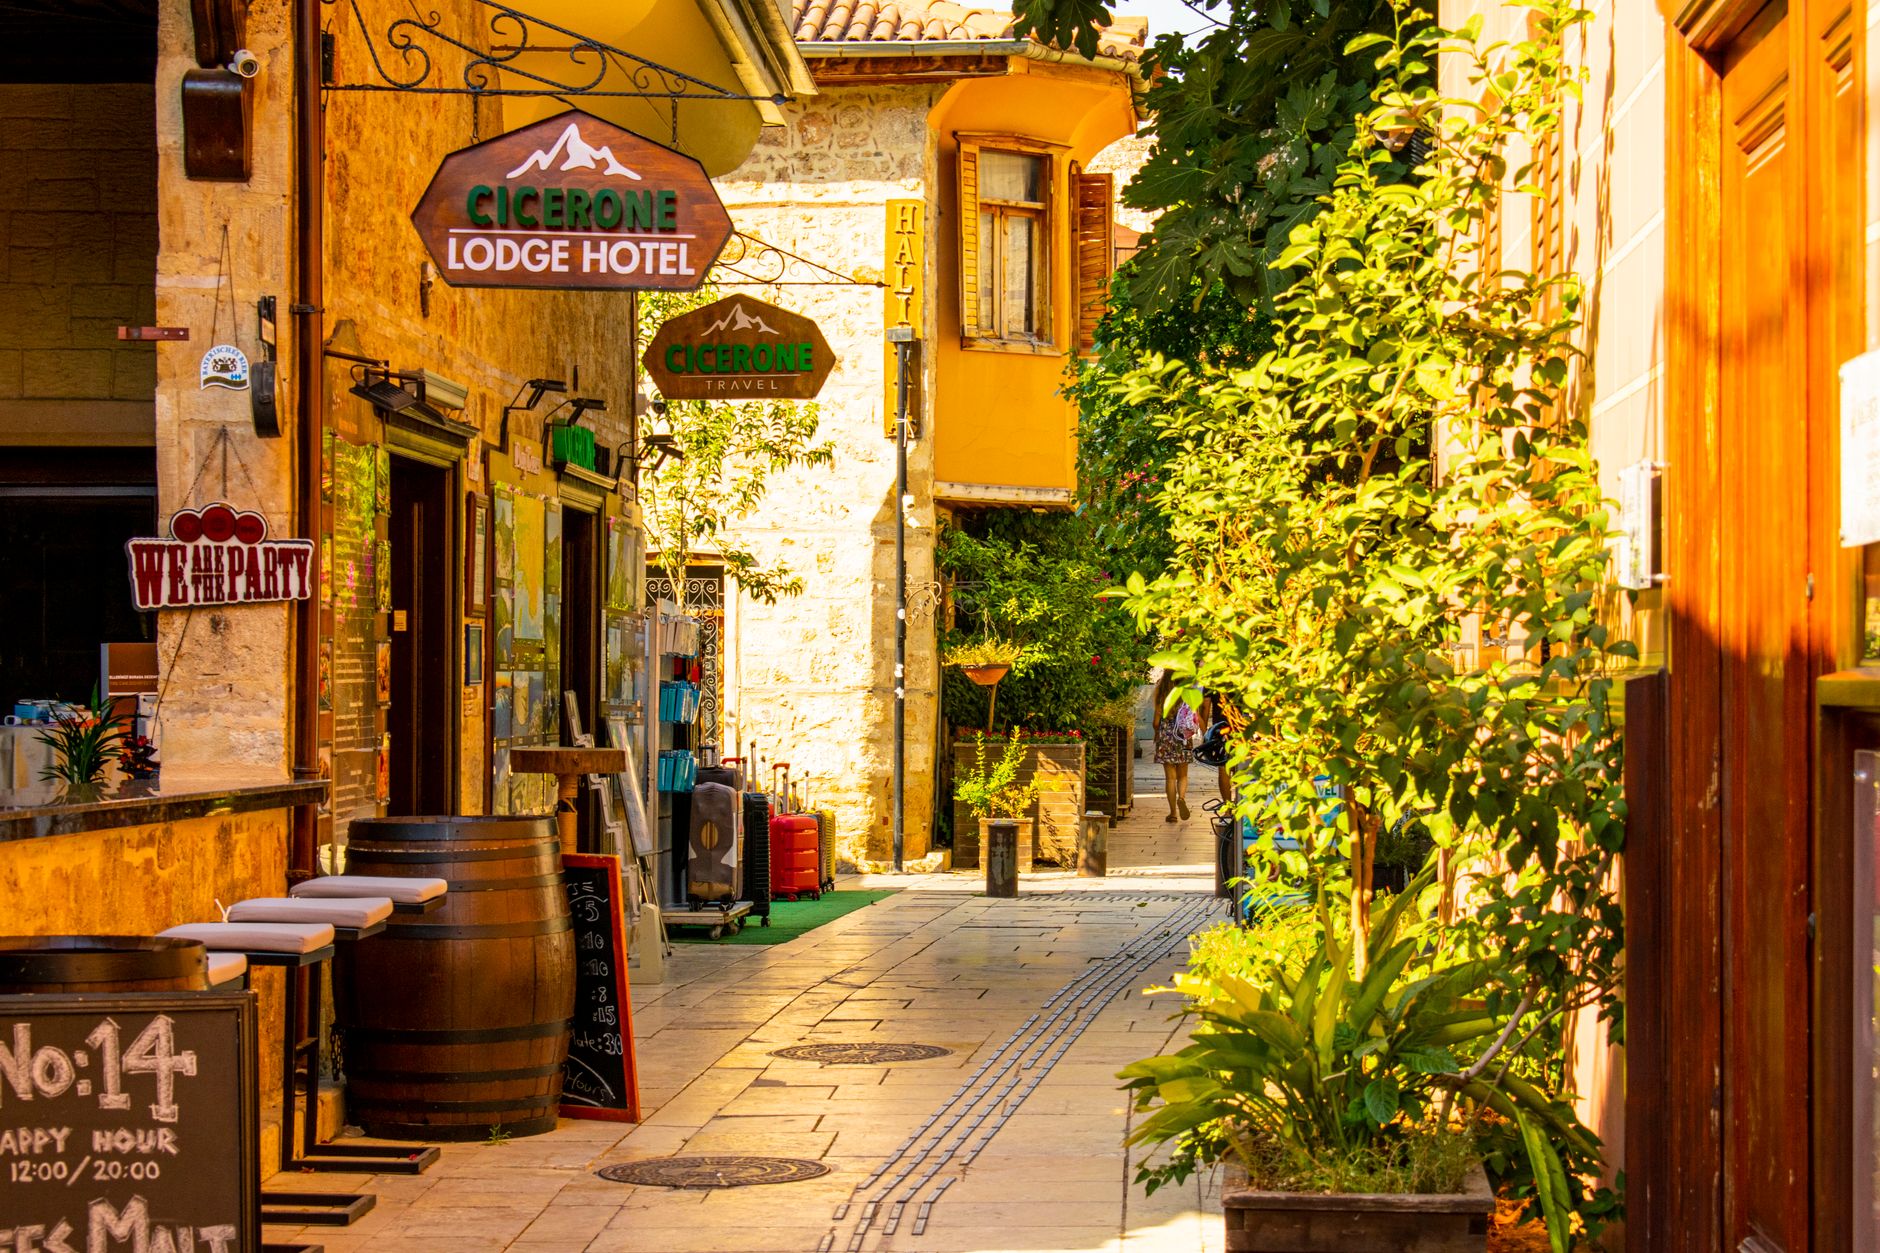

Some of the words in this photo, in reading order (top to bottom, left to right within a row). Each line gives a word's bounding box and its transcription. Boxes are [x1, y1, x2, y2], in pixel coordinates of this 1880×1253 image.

[466, 184, 677, 230] CICERONE
[448, 237, 569, 273] LODGE
[582, 240, 695, 276] HOTEL
[665, 341, 813, 374] CICERONE
[705, 379, 778, 391] TRAVEL
[131, 543, 189, 605] WE
[191, 545, 225, 573] ARE
[227, 546, 311, 600] PARTY
[191, 574, 225, 602] THE
[0, 1127, 72, 1155] APPY
[92, 1127, 180, 1155] HOUR
